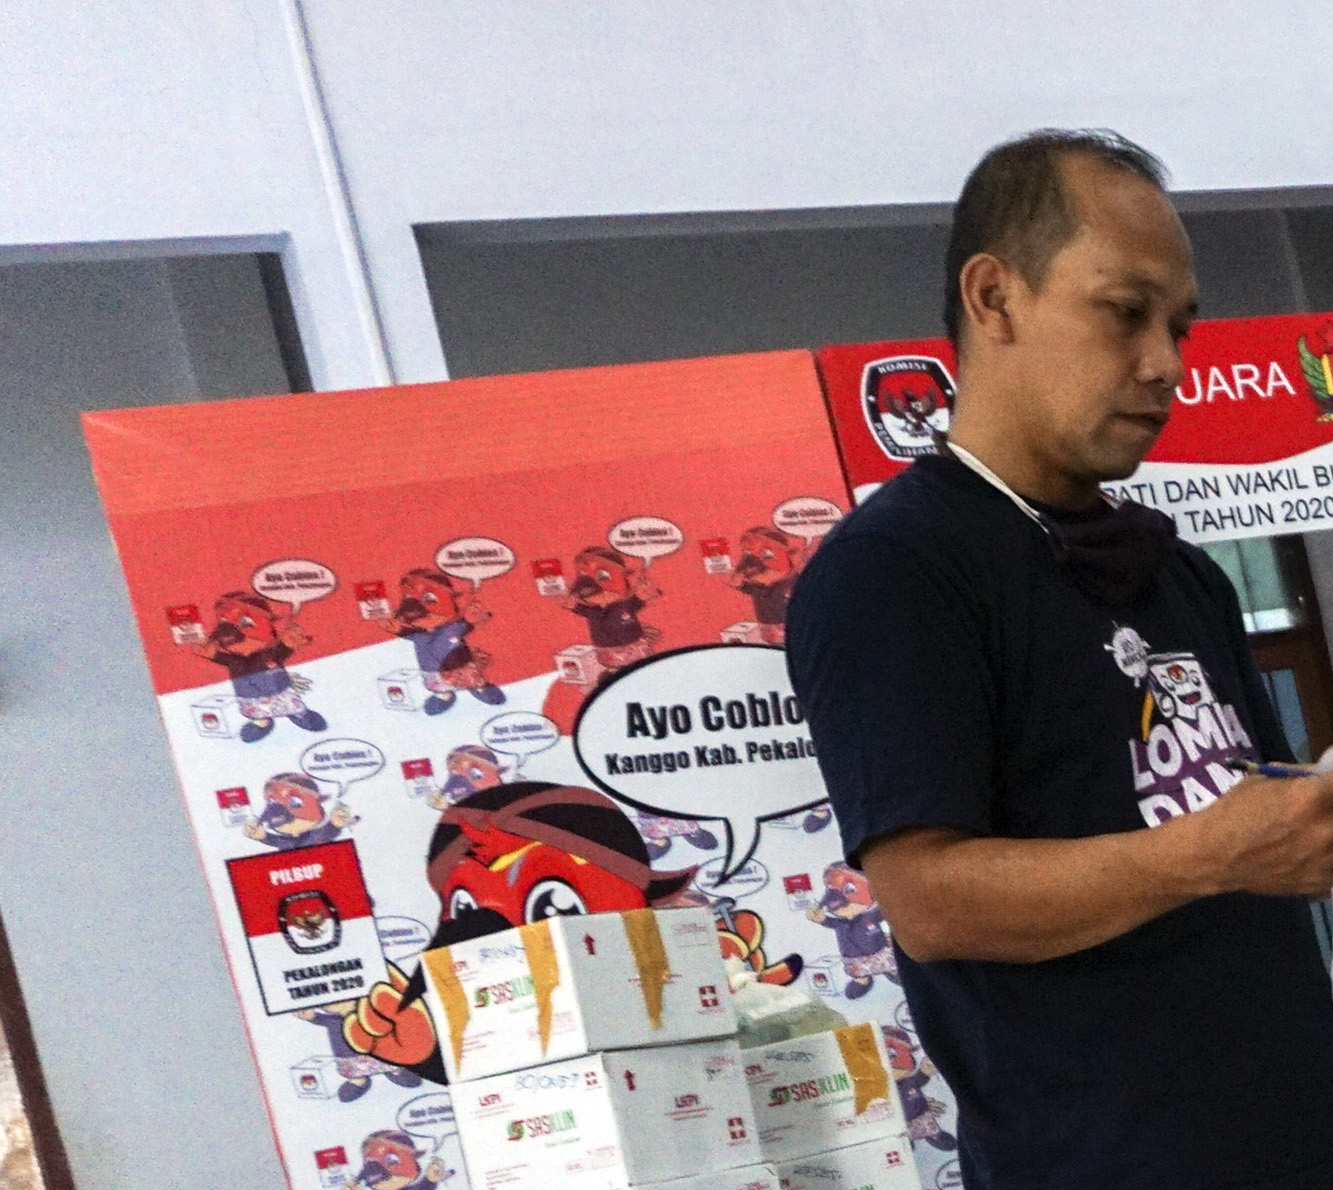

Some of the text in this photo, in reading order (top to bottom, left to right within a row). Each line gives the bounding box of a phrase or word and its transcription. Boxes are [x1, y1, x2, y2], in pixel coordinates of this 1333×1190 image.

[1162, 475, 1221, 504] DAN
[1218, 467, 1309, 497] WAKIL
[1184, 501, 1277, 534] TAHUN
[626, 702, 693, 741] Ayo
[605, 749, 692, 776] Kanggo
[693, 742, 744, 768] Kab.
[268, 863, 325, 887] PILBUP
